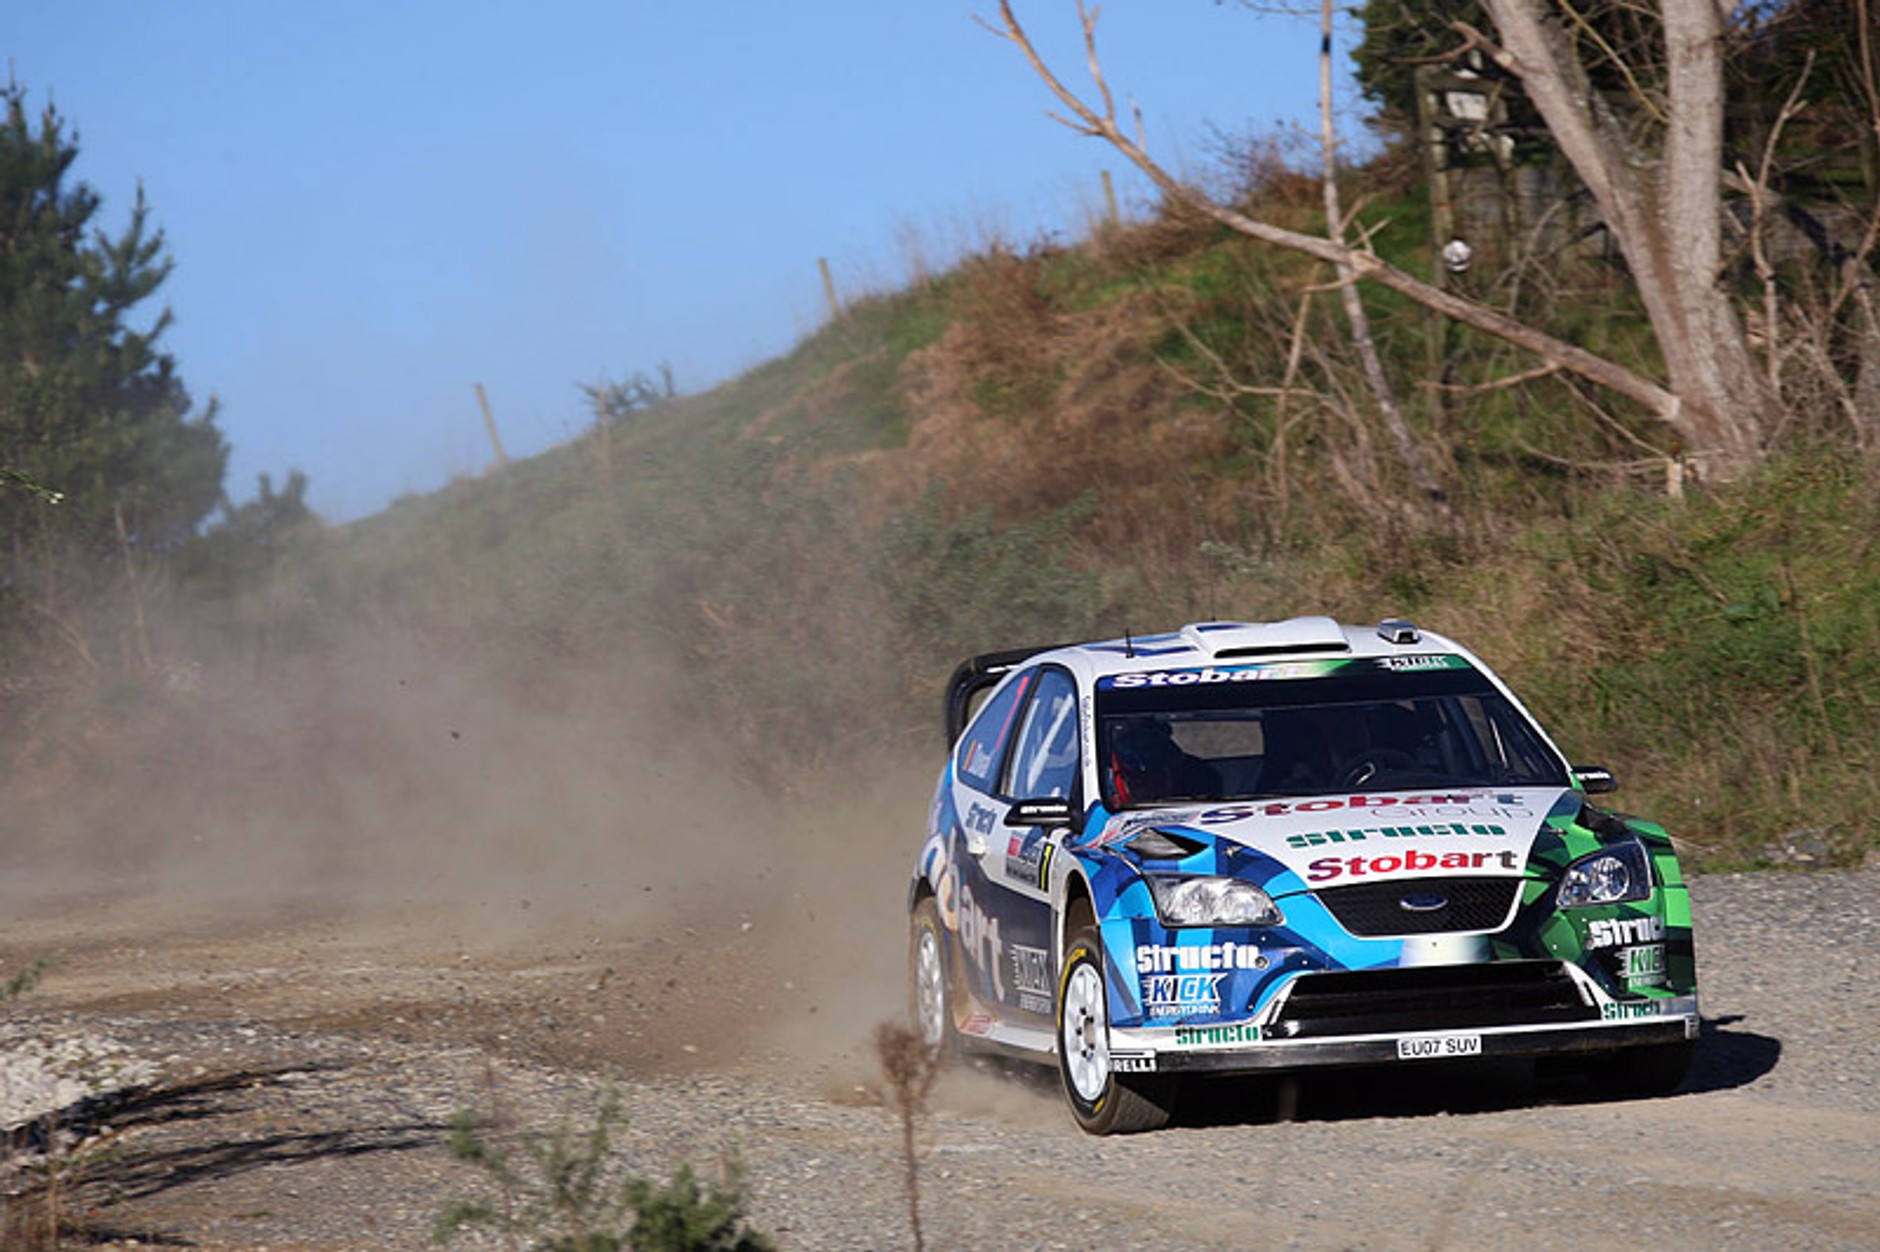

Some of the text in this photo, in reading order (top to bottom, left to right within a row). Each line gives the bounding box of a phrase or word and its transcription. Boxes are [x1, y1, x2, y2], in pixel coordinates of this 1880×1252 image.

[1200, 793, 1524, 826] Stobart
[1307, 850, 1519, 882] Stobart
[1151, 976, 1217, 1002] KICK
[1401, 1038, 1477, 1056] EU07 SUV
